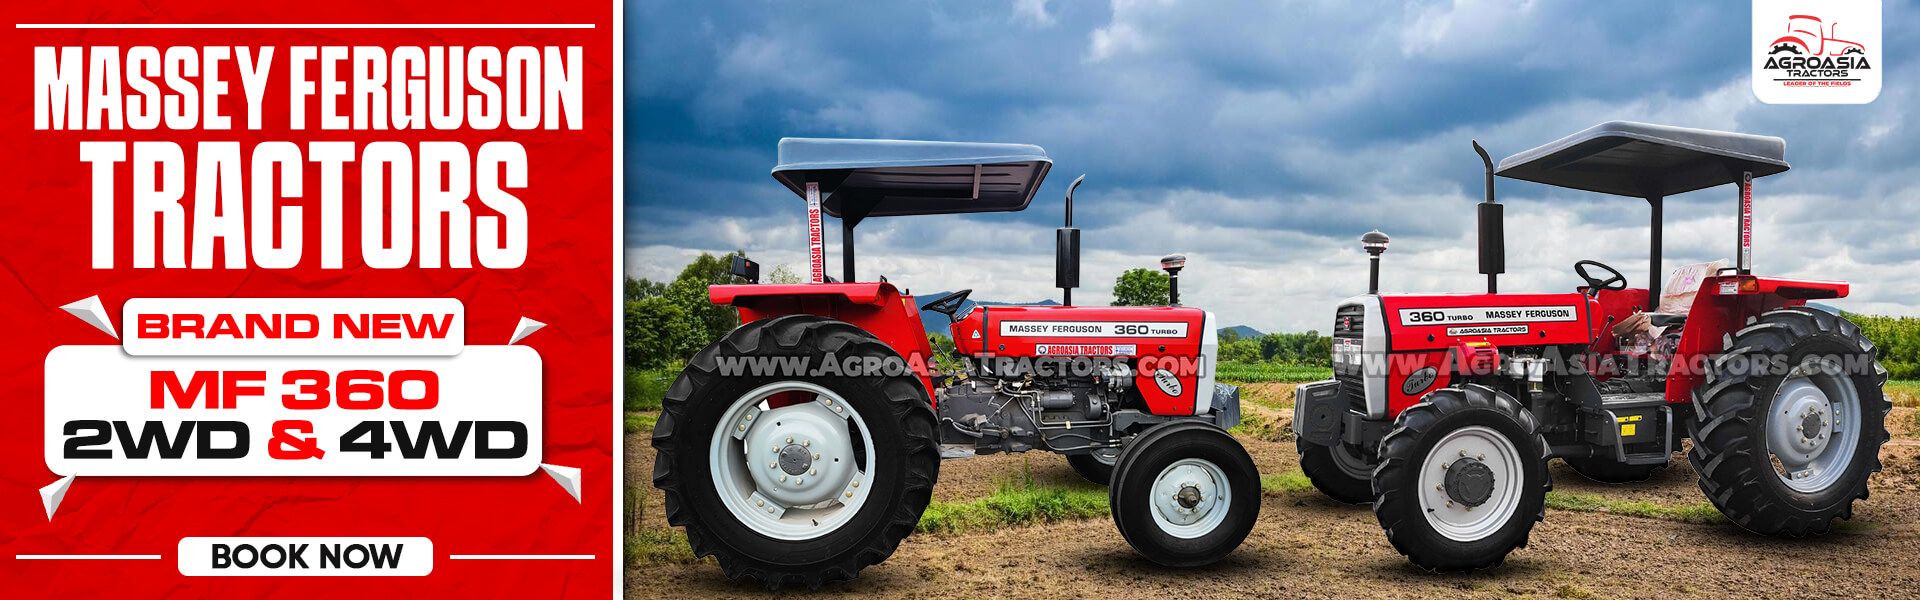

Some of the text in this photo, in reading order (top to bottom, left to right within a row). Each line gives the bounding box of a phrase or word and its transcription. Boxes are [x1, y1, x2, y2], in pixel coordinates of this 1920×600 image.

[1744, 183, 1752, 214] AGROASIA
[809, 209, 821, 245] TRACTORS
[1743, 215, 1751, 247] TRACTORS
[811, 247, 822, 282] AGROASIA
[1009, 325, 1049, 333] MASSEY
[1052, 325, 1102, 333] FERGUSON
[1114, 324, 1149, 335] 360
[1409, 311, 1445, 322] 360
[1485, 310, 1522, 319] MASSEY
[1525, 309, 1570, 318] FERGUSON
[1047, 345, 1079, 355] AGROASIA
[1080, 345, 1113, 355] TRACTORS
